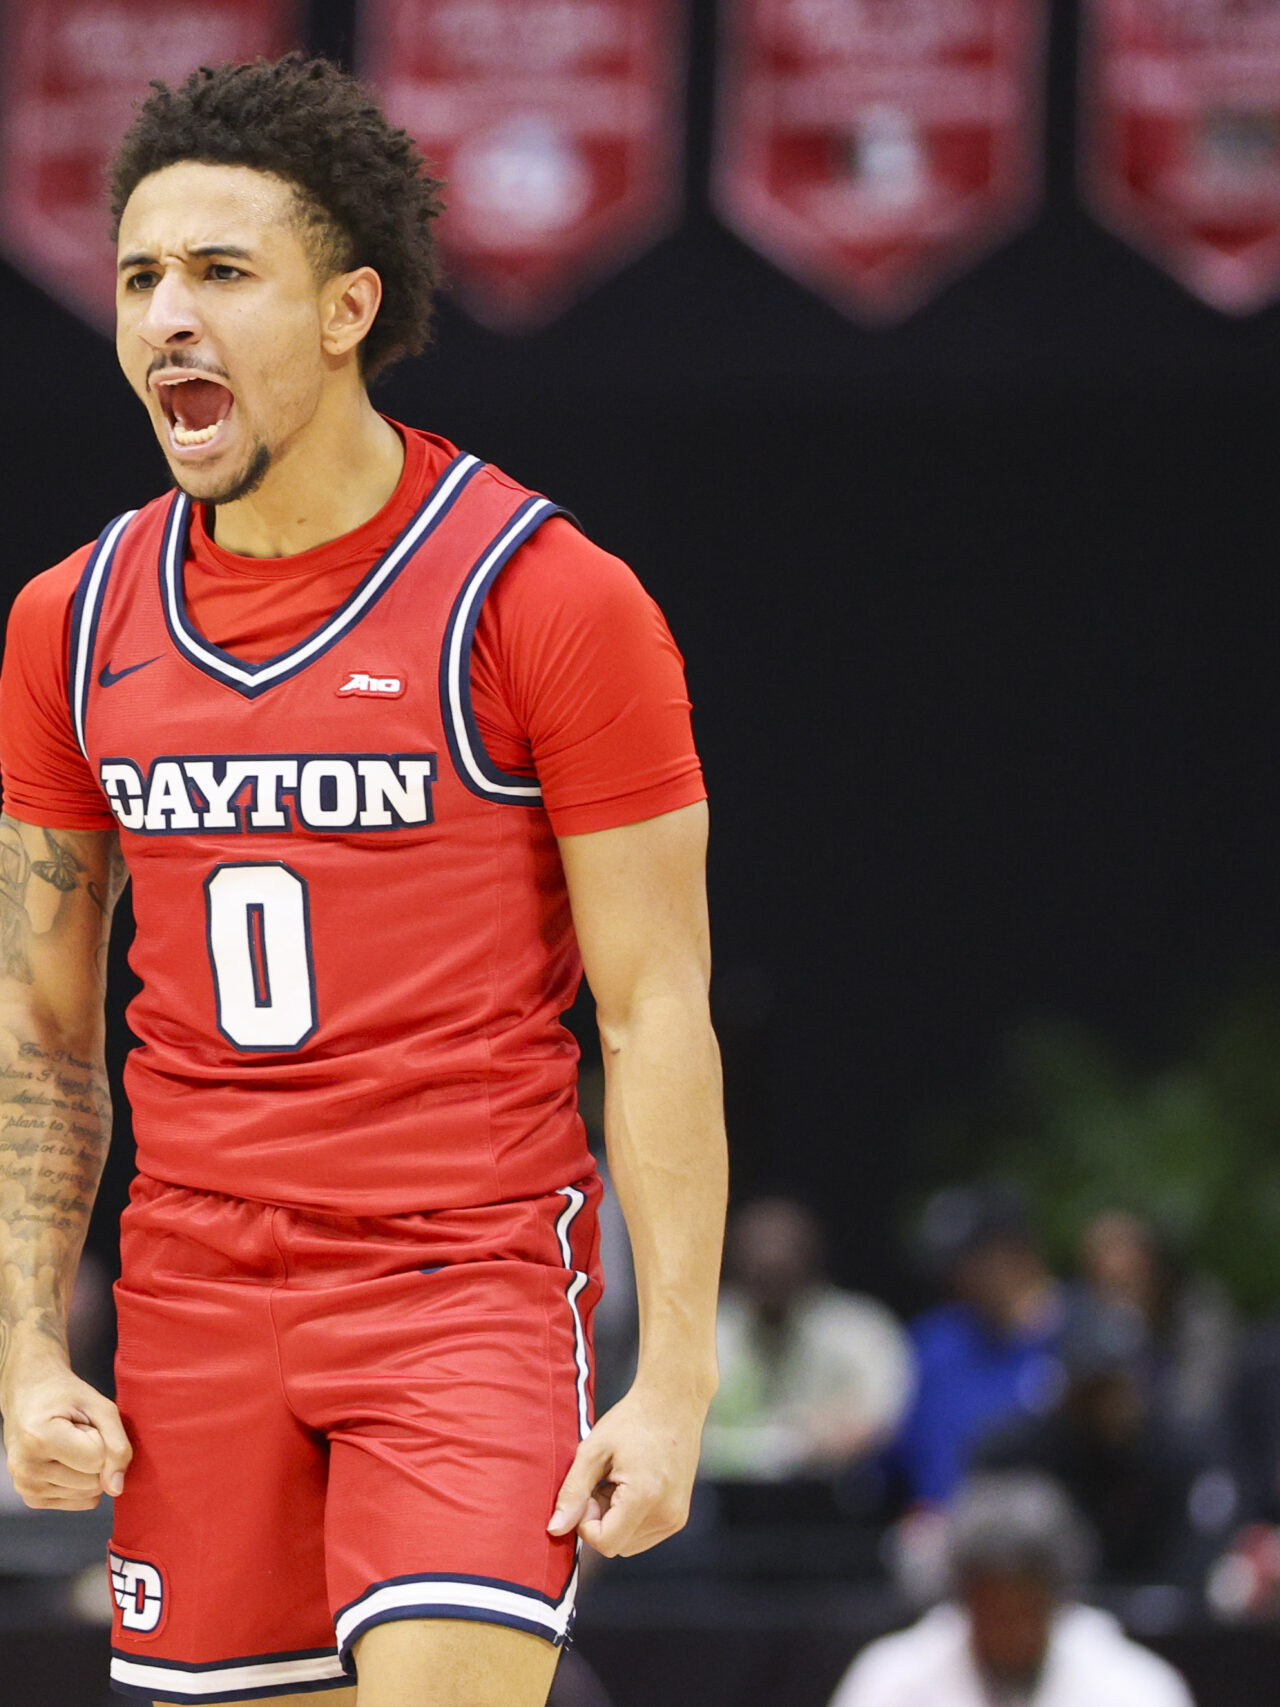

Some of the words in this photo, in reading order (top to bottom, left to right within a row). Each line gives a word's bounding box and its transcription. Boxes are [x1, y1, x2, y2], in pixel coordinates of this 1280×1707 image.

[338, 673, 402, 694] A10
[100, 753, 437, 836] DAYTON
[204, 861, 318, 1052] 0
